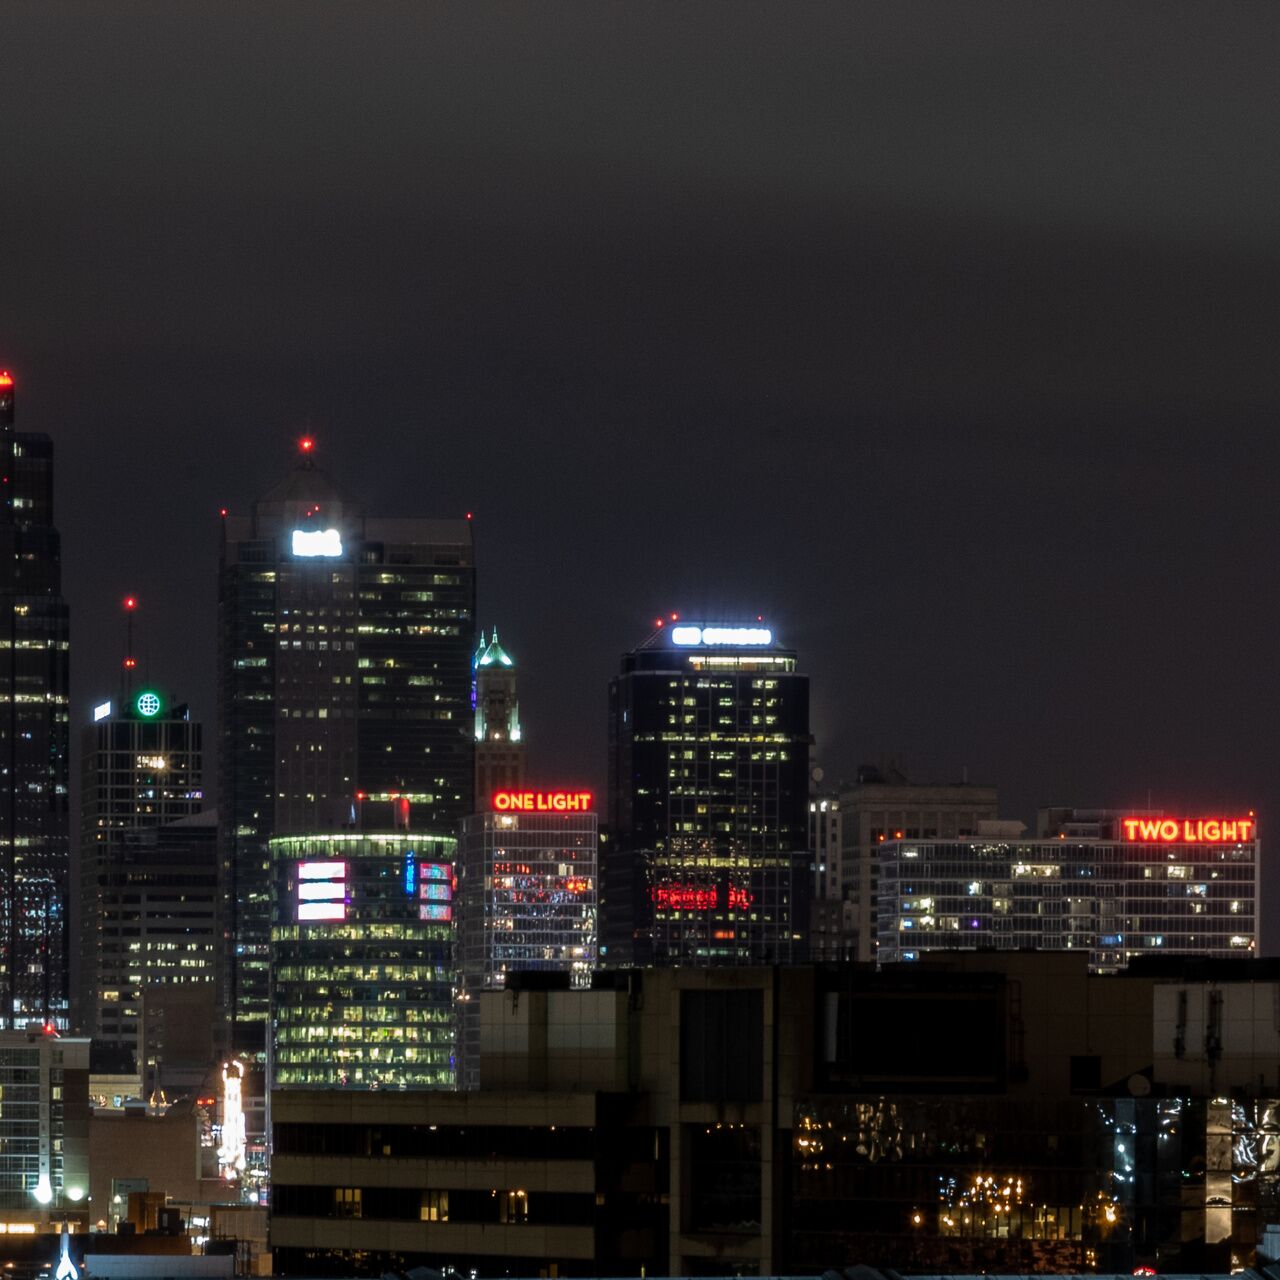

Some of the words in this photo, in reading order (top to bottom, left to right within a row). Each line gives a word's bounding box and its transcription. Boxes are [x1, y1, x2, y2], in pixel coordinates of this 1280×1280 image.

[495, 793, 534, 810] ONE
[536, 793, 591, 810] LIGHT
[1124, 820, 1179, 841] TWO
[1184, 820, 1252, 841] LIGHT
